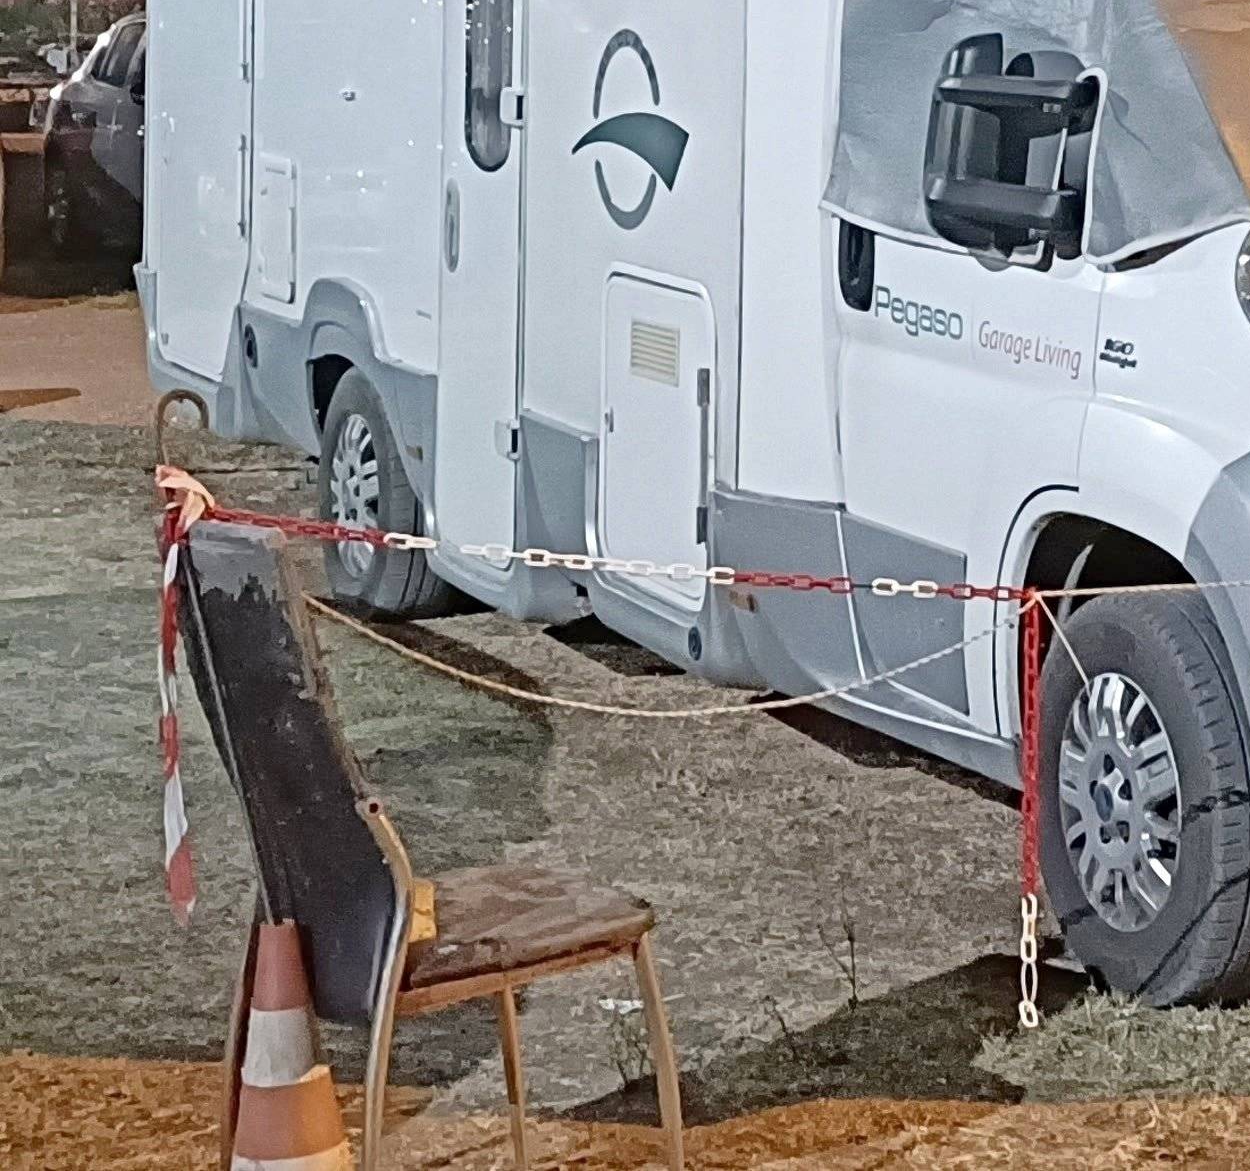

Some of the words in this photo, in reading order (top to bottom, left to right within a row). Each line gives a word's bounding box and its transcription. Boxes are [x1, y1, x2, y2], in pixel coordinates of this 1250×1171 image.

[874, 284, 964, 340] Pegaso
[978, 320, 1031, 365] Garage
[1034, 336, 1082, 380] Living
